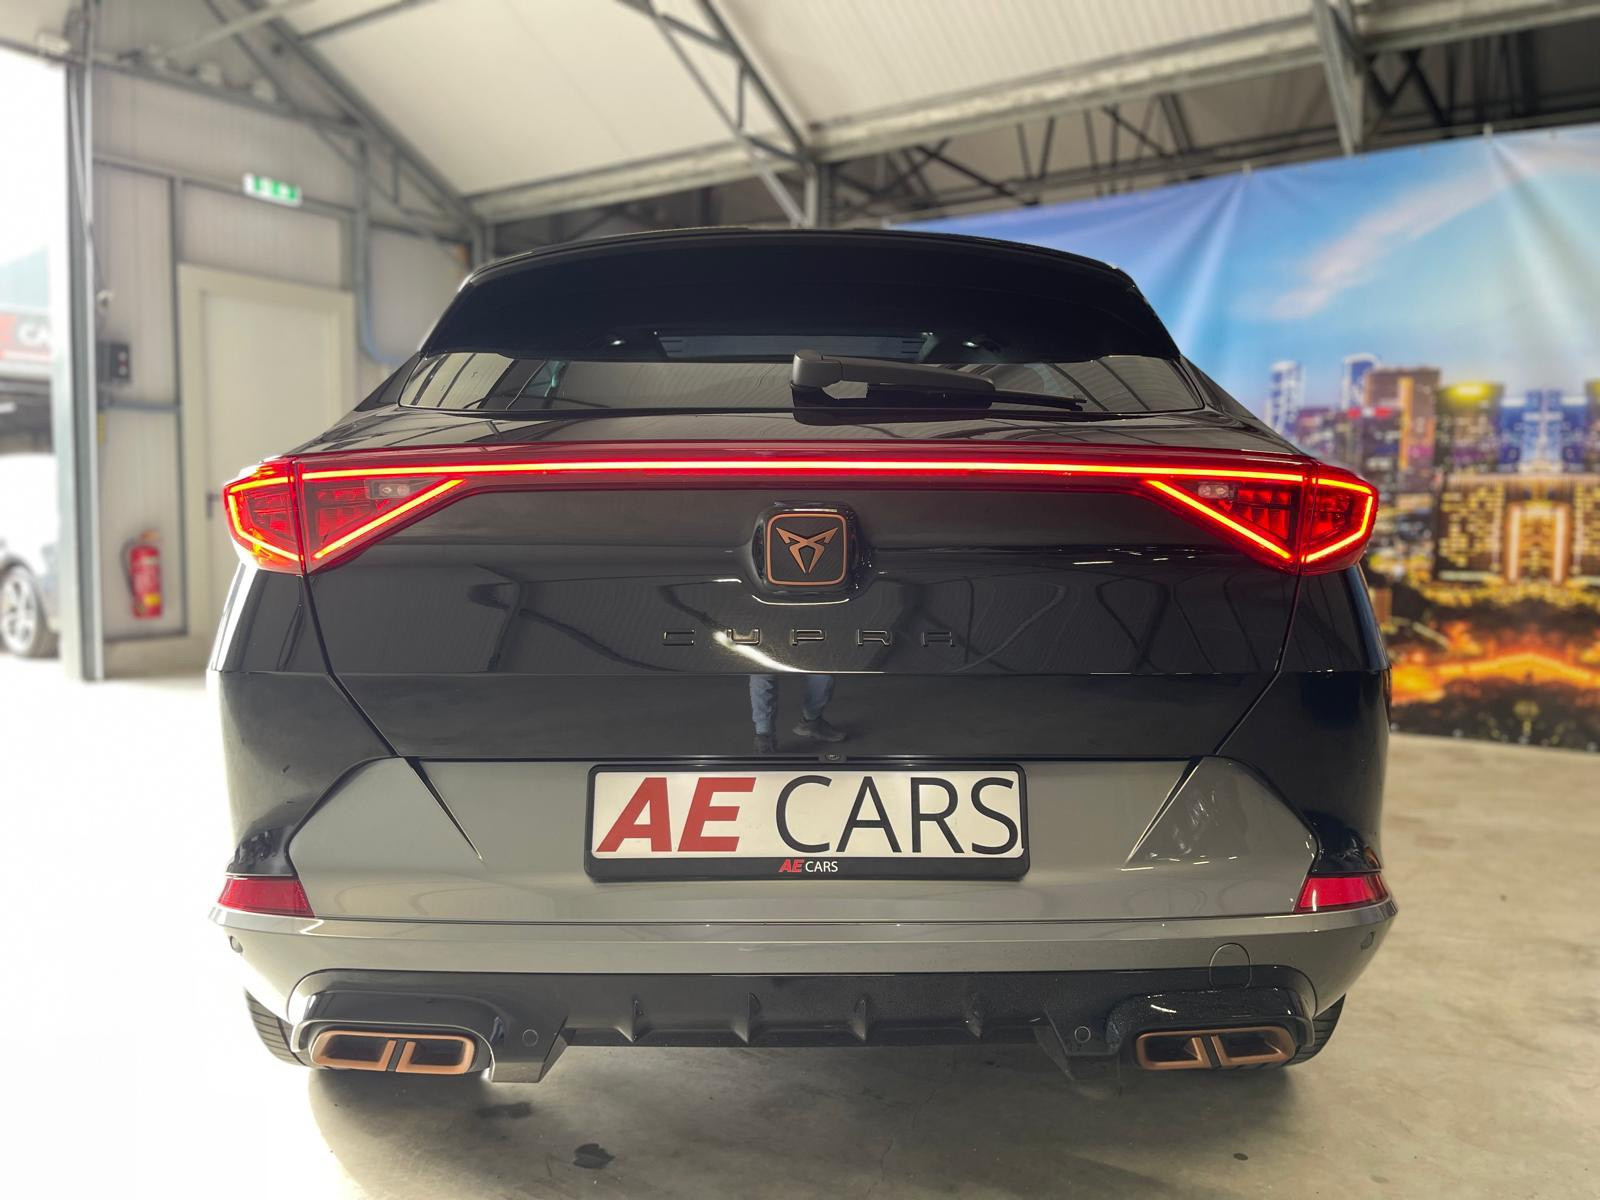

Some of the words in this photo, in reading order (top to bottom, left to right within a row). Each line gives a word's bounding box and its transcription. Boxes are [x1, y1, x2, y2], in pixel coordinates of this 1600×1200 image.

[663, 629, 954, 647] CUPRA
[596, 777, 757, 852] AE
[776, 775, 1019, 855] CARS
[778, 859, 804, 872] AE
[805, 861, 838, 872] CARS
